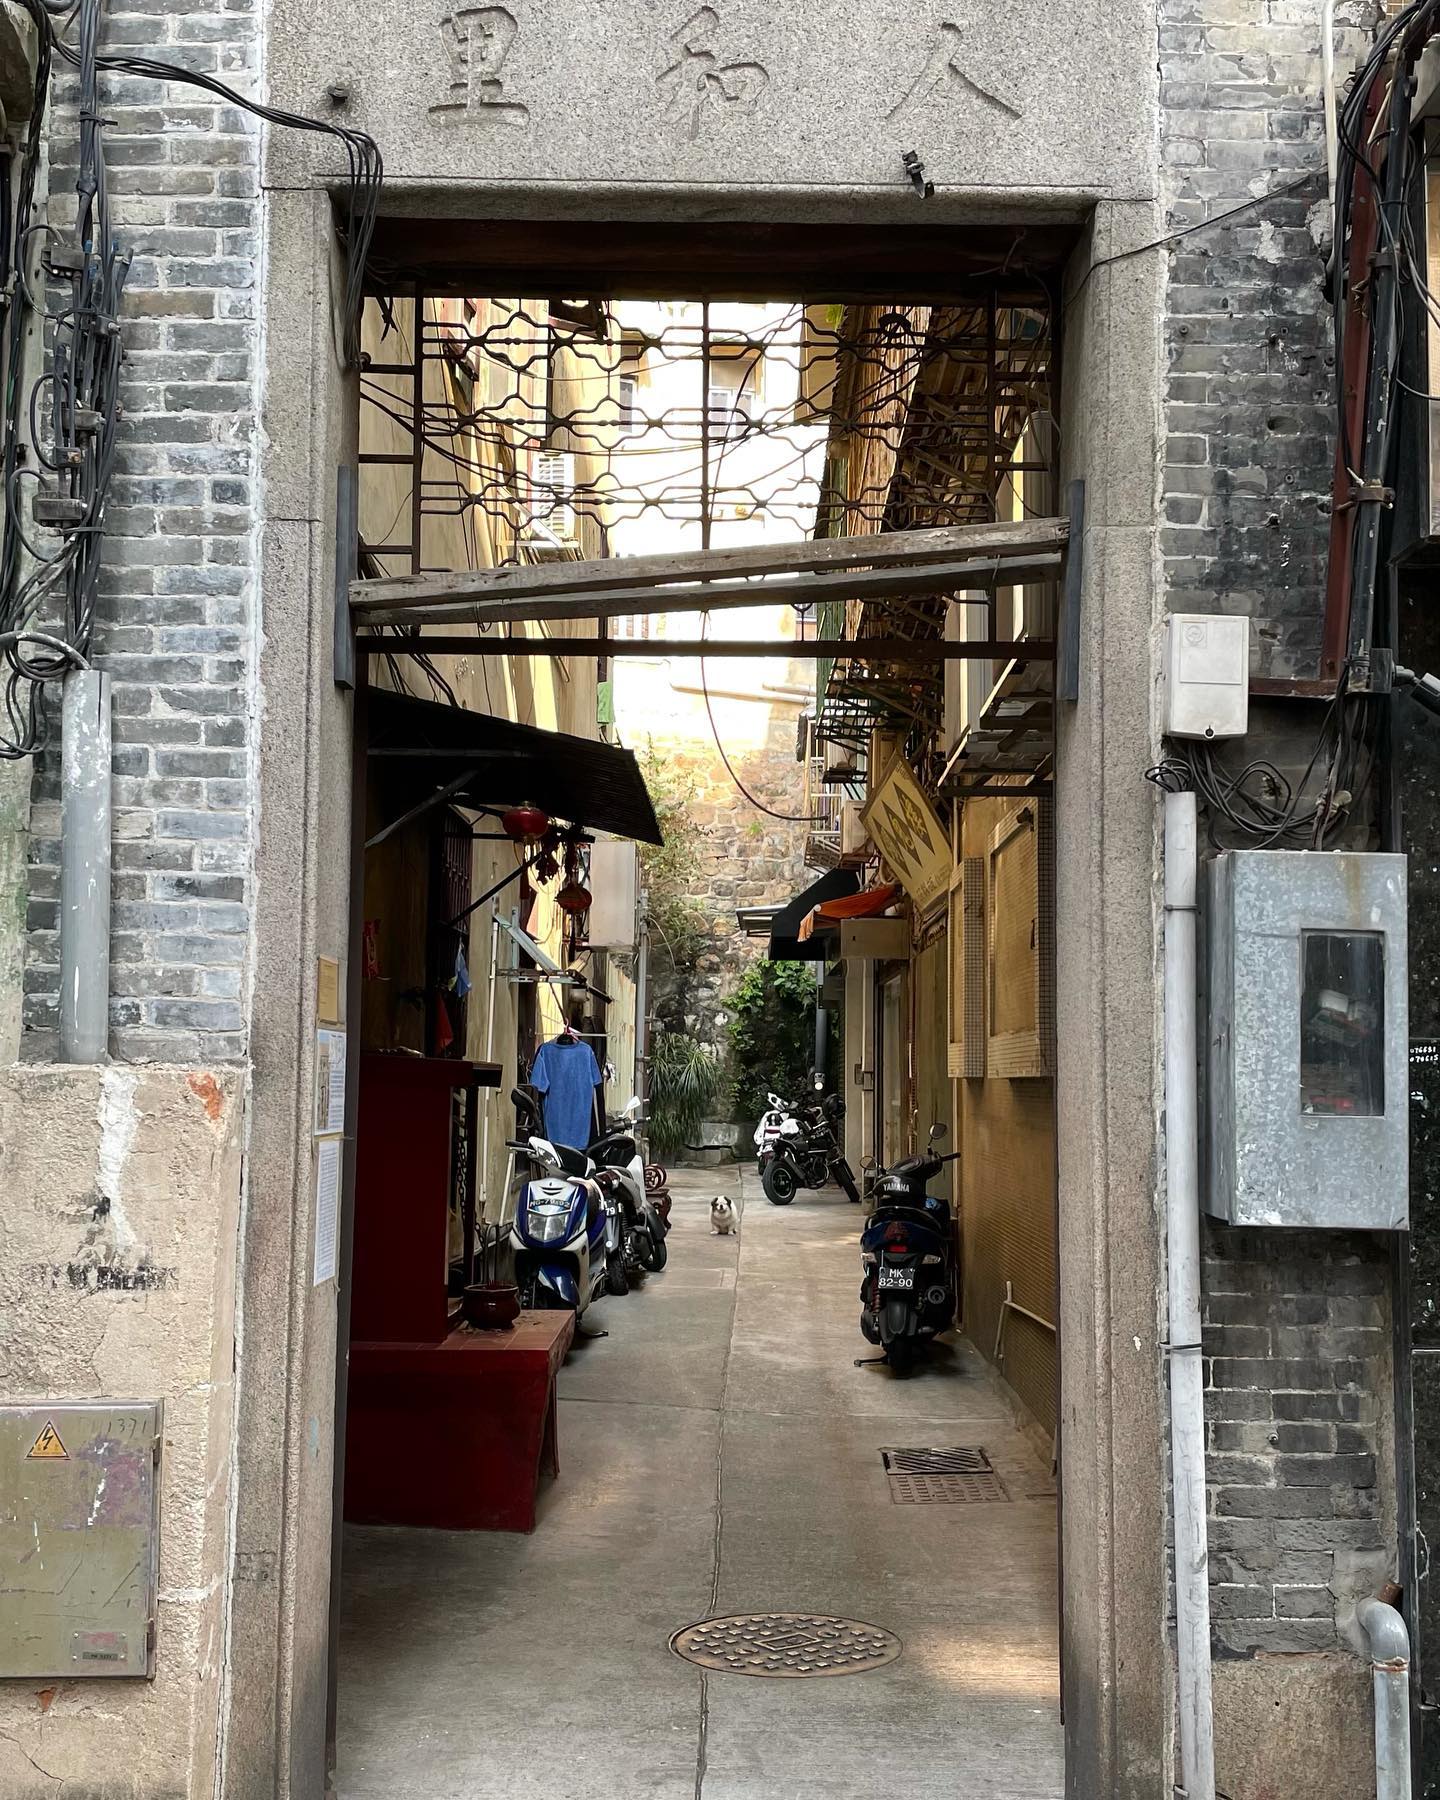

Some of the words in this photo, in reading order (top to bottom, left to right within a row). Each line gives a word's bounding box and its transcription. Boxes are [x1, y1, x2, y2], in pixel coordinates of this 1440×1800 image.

[883, 1182, 910, 1192] YAMAHA
[889, 1268, 904, 1278] MK
[879, 1277, 913, 1287] 82-90
